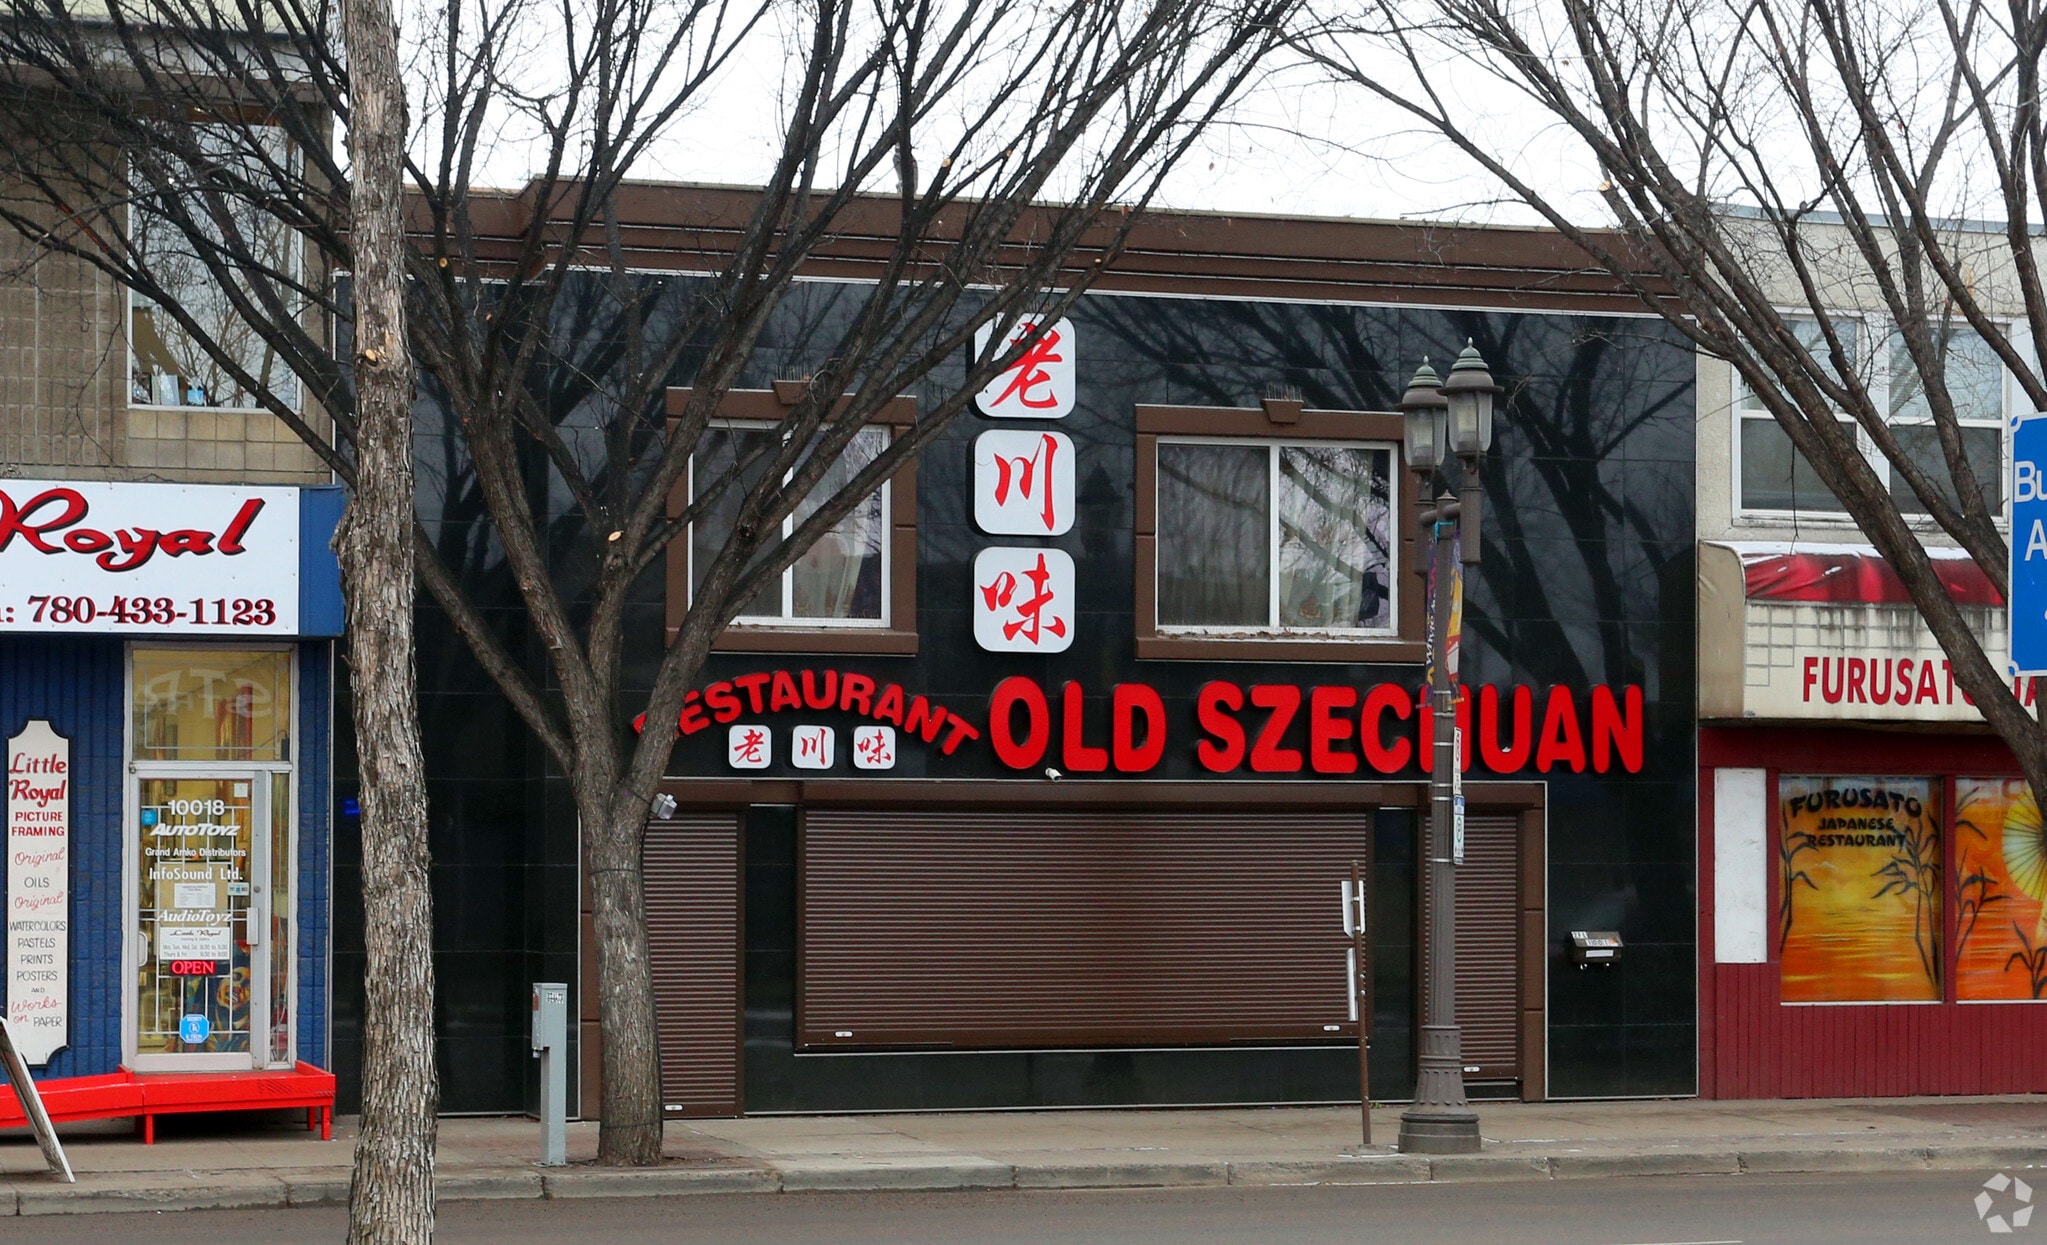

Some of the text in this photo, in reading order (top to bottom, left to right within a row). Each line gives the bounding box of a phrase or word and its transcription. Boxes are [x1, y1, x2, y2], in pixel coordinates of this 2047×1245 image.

[0, 488, 265, 572] Royal
[27, 595, 276, 626] 780-433-1123
[1803, 657, 1976, 706] FURUSAT
[632, 669, 980, 755] ESTAURANT
[989, 676, 1166, 773] OLD
[1196, 680, 1643, 774] SZECHUAN
[733, 728, 892, 766] 老川味
[8, 752, 67, 774] Little
[9, 779, 67, 808] Royal
[168, 799, 225, 815] 10018
[1790, 788, 1922, 818] FURUSATO
[15, 811, 63, 821] PICTURE
[1818, 818, 1894, 830] JAPANESE
[11, 826, 65, 836] FRAMING
[1807, 834, 1905, 848] RESTAURANT
[14, 846, 65, 868] Original
[145, 847, 246, 857] Grand Amko Distributors
[149, 867, 243, 880] InfoSound Ltd.
[24, 877, 50, 888] OILS
[14, 891, 64, 911] Original
[159, 909, 232, 926] AudioToyz
[9, 920, 66, 932] WATERCOLORS
[17, 937, 56, 948] PASTELS
[20, 954, 54, 965] PRINTS
[171, 960, 216, 975] OPEN
[16, 970, 58, 981] POSTERS
[11, 996, 62, 1013] Works
[13, 1014, 63, 1028] on PAPER
